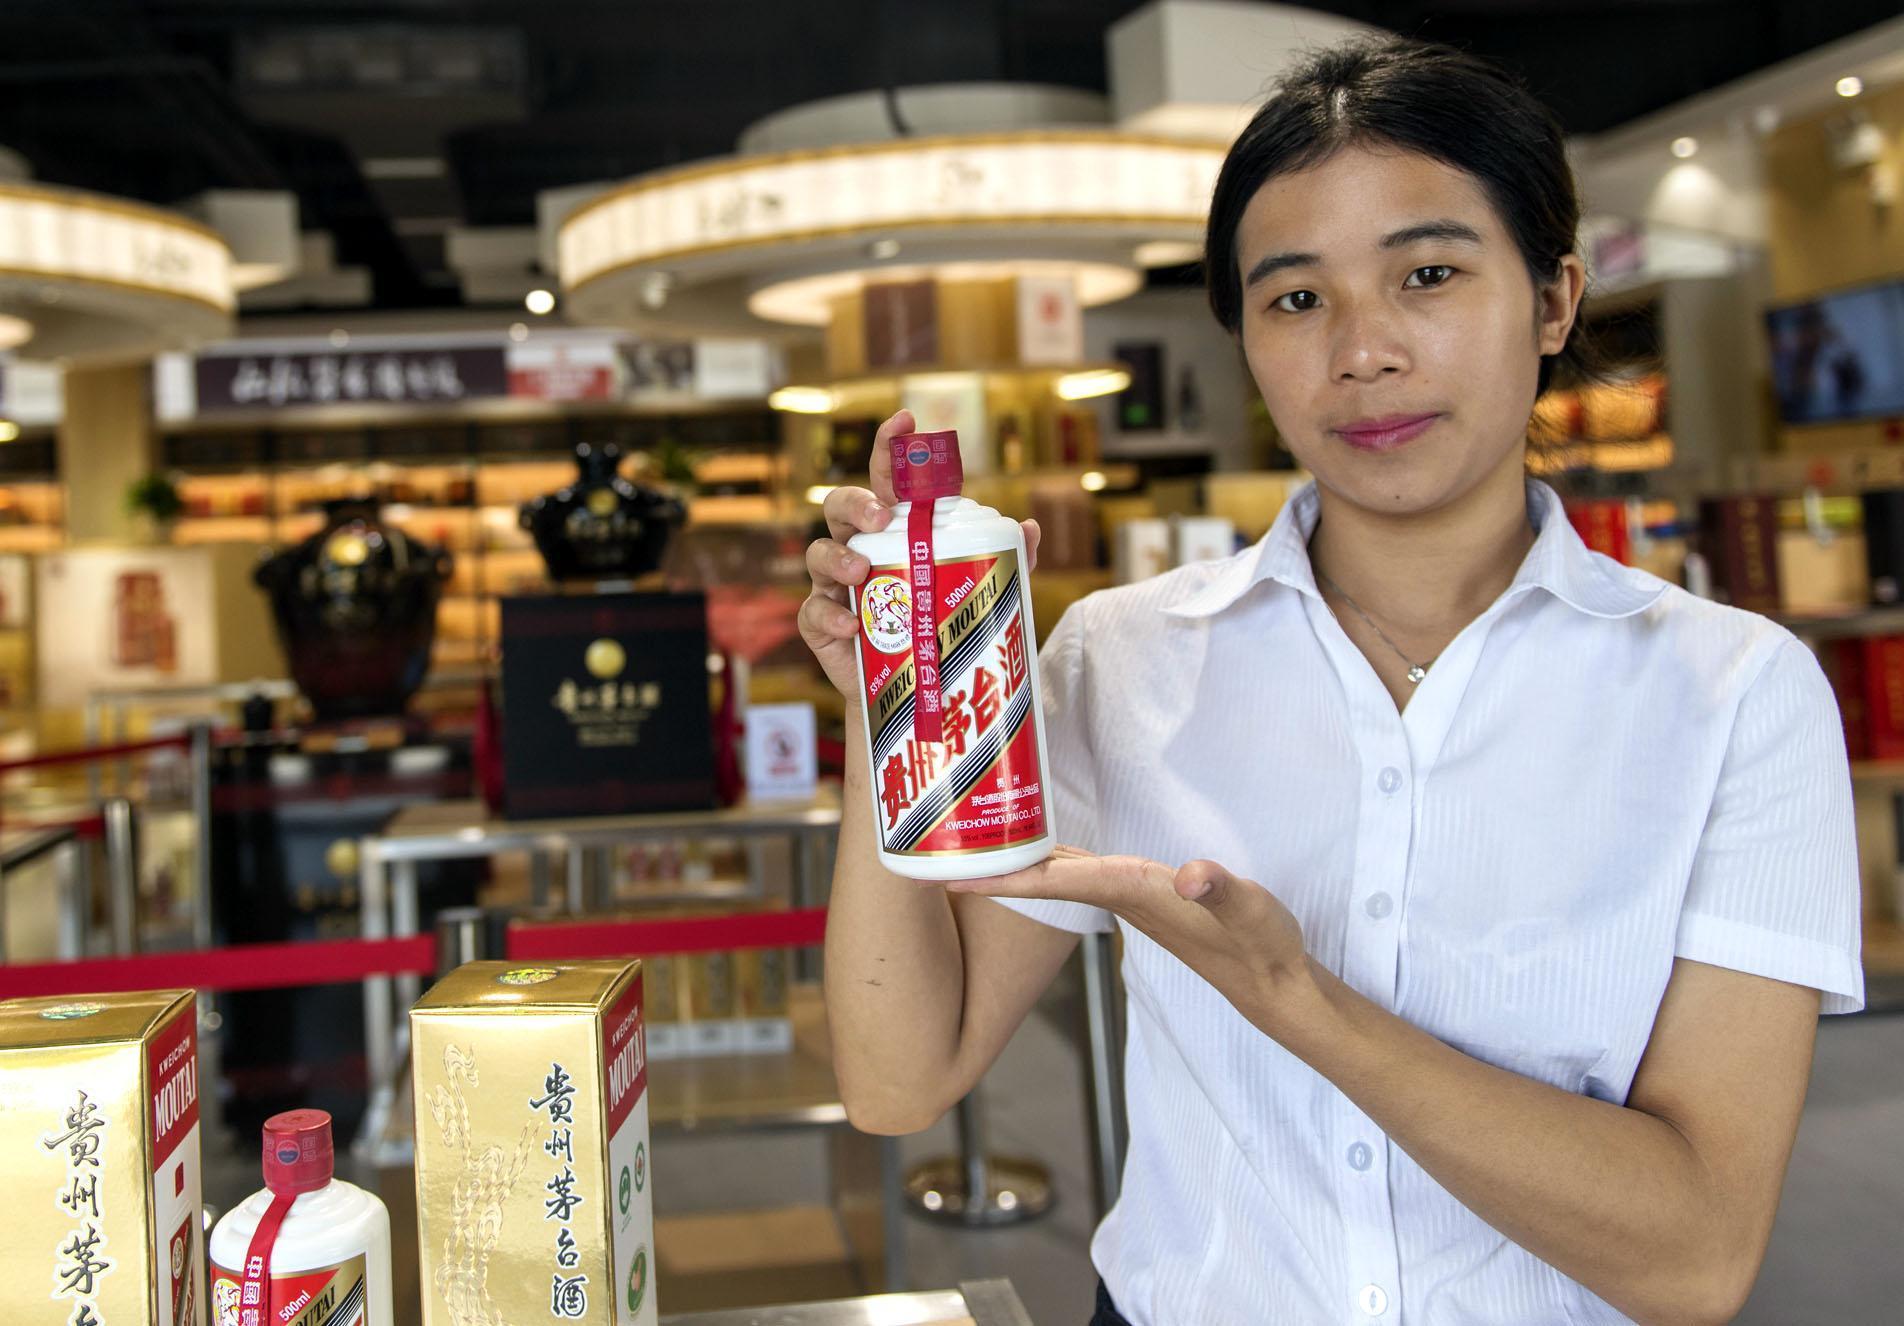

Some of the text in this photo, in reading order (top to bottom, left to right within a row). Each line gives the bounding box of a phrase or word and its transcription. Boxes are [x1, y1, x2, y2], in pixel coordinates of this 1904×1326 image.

[945, 576, 976, 608] 500ml
[948, 574, 998, 646] MOUTAI
[880, 664, 892, 681] vol
[945, 818, 990, 831] KWEICHOW
[991, 812, 1019, 826] MOUTAI
[981, 803, 1021, 816] PRODUCE OF
[611, 1004, 639, 1048] KWEICHOW
[158, 1034, 191, 1077] KWEICHOW
[608, 1023, 645, 1113] MOUTAI
[153, 1055, 197, 1143] MOUTAI
[278, 1289, 311, 1321] 500ml
[296, 1285, 335, 1326] UTAI
